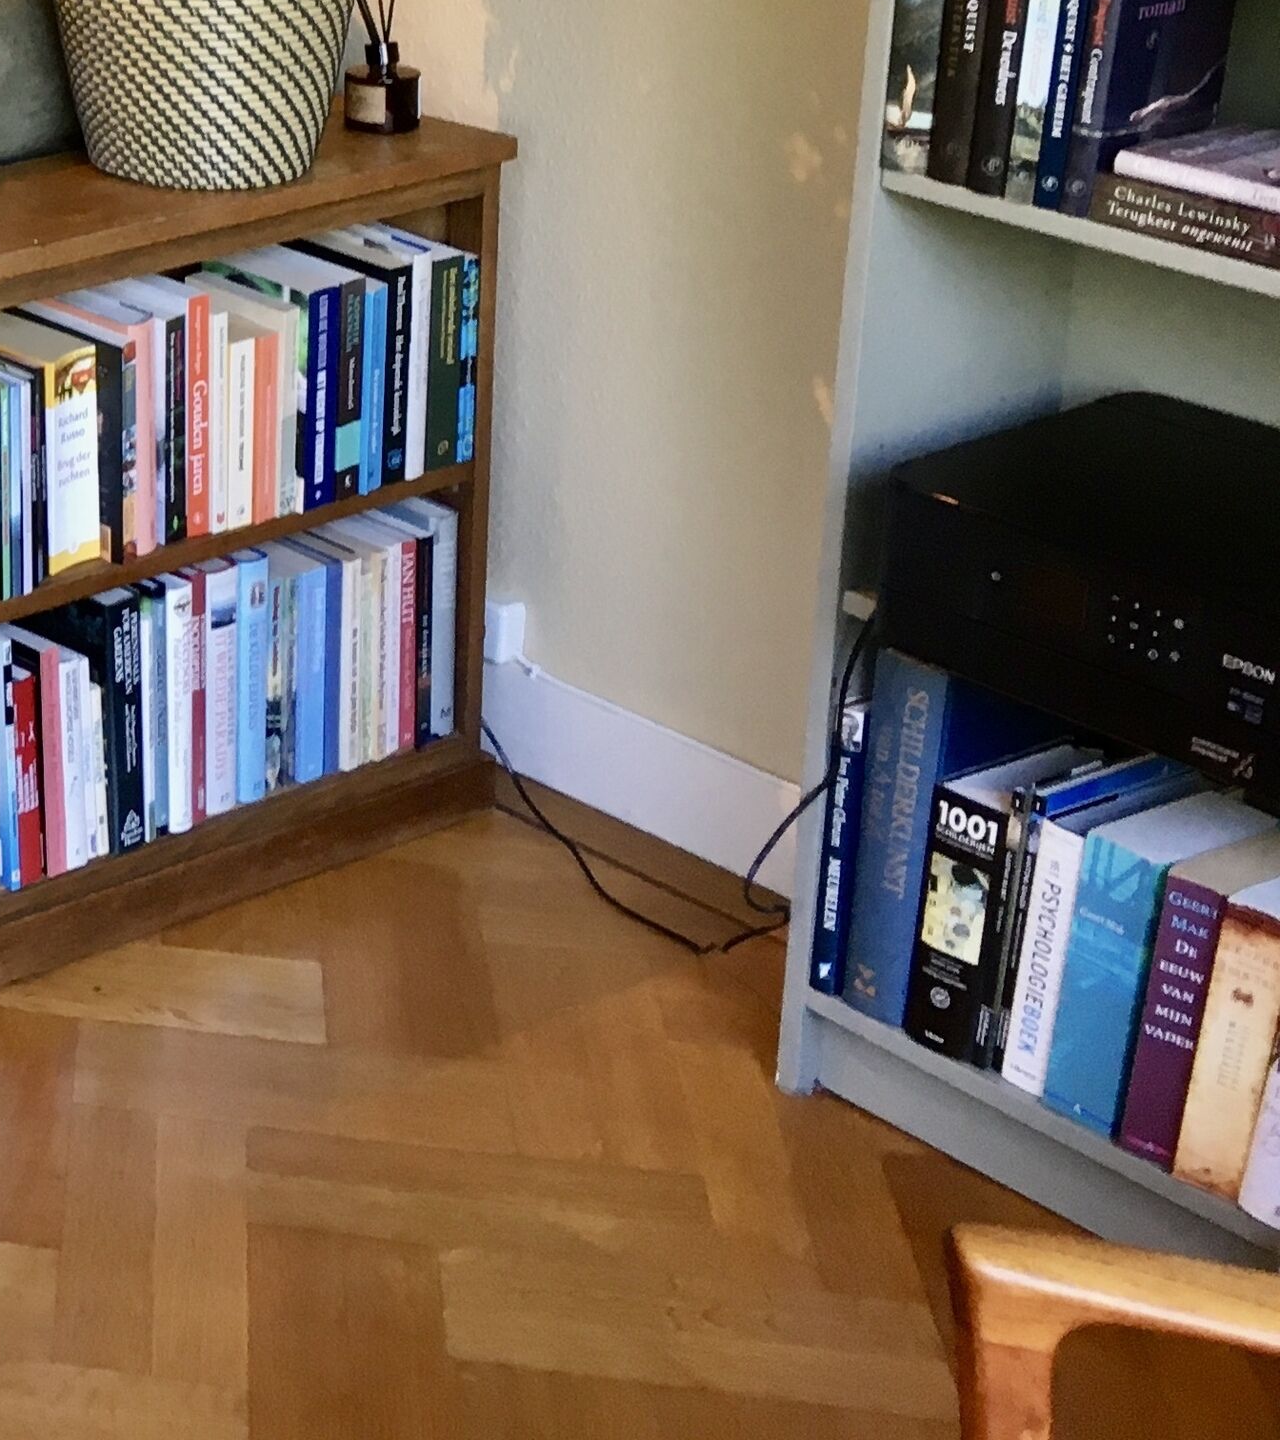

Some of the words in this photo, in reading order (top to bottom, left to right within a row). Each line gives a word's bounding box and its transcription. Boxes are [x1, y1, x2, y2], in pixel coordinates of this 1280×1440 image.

[1114, 185, 1171, 214] Charles
[1178, 201, 1252, 235] Lewinsky
[1106, 200, 1177, 232] Terugkeer
[1181, 222, 1254, 253] ongewenst
[58, 407, 89, 428] Richard
[193, 380, 208, 450] Gouden
[60, 428, 85, 445] Russo
[75, 450, 90, 464] der
[189, 453, 205, 495] jaren
[402, 552, 413, 583] JAN
[402, 587, 414, 625] HUT
[113, 626, 124, 684] GARDENS
[1222, 653, 1276, 685] EPSON
[215, 650, 227, 704] WREDE
[880, 688, 930, 900] SCHILDERKUNST
[939, 799, 999, 847] 1001
[1169, 891, 1220, 921] GEERT
[1170, 914, 1211, 940] MAK
[1174, 938, 1199, 960] DE
[1017, 879, 1062, 1056] PSYCHOLOGIEBOEK
[1158, 959, 1206, 986] EEUW
[1161, 982, 1195, 1006] VAN
[1154, 1003, 1194, 1029] MIJN
[1144, 1022, 1196, 1051] VADER
